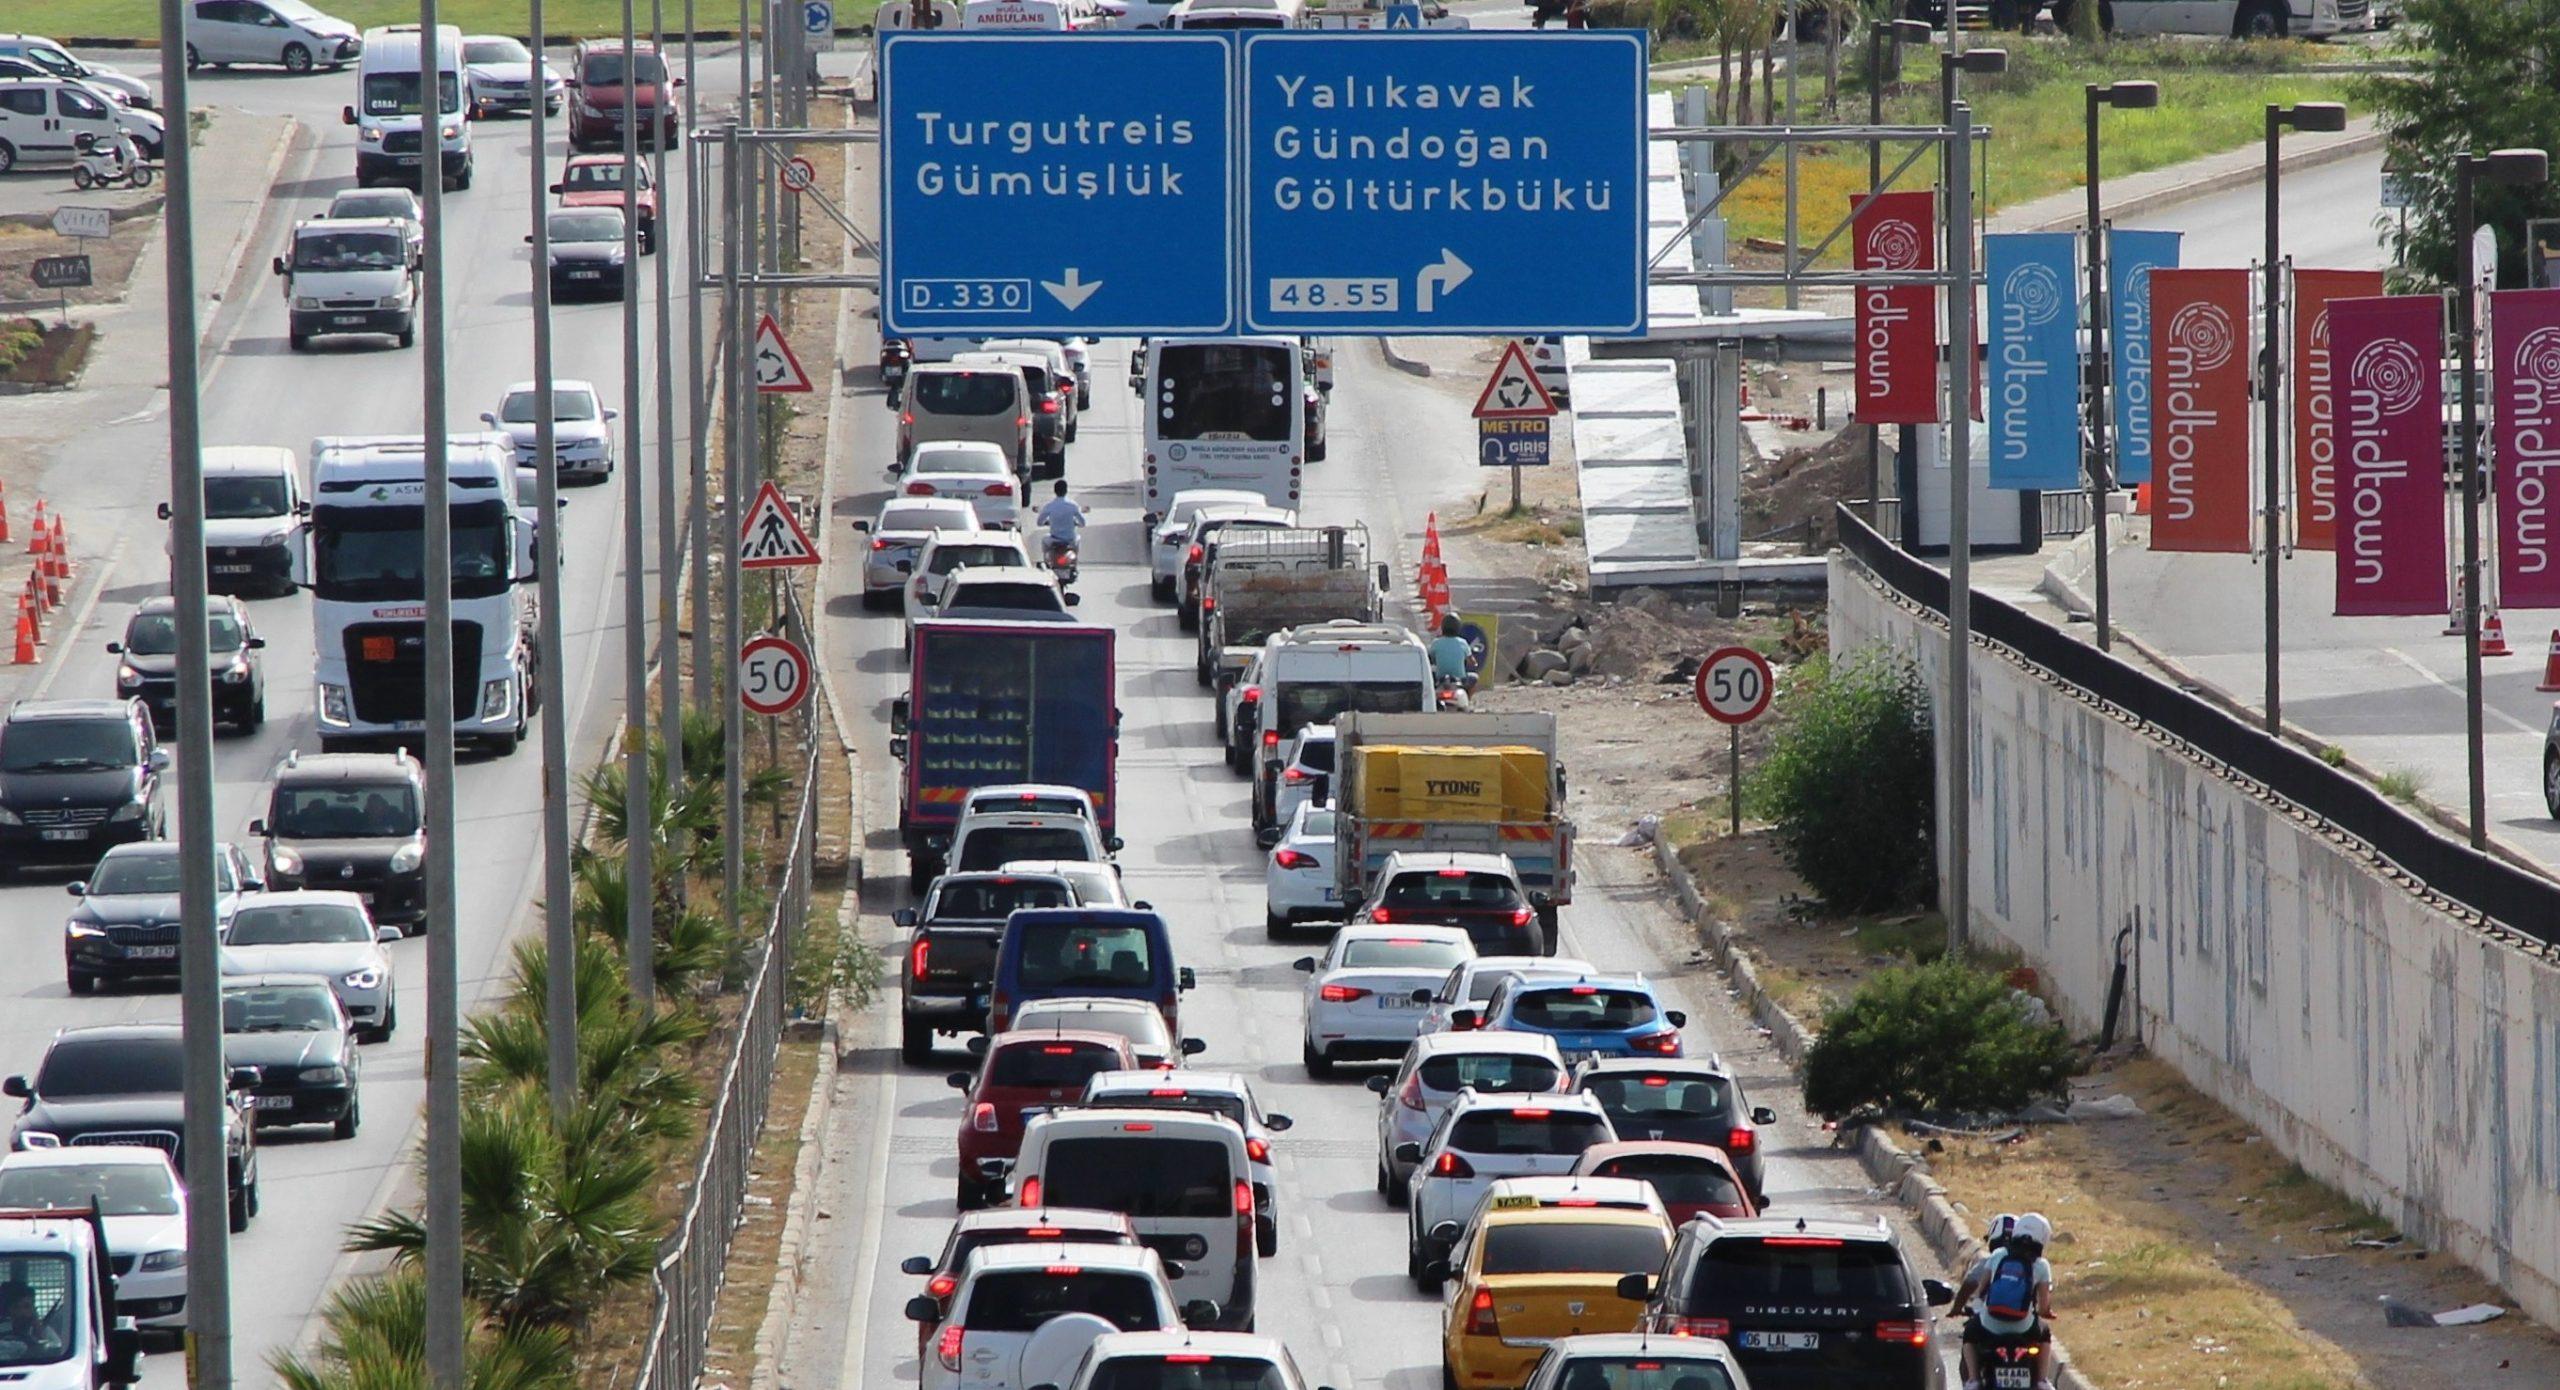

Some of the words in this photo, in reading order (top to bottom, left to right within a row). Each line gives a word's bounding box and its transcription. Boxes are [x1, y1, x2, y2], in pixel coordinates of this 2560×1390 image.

[977, 14, 1045, 24] AMBULANS
[1274, 75, 1536, 109] Yalıkavak
[916, 112, 1194, 154] Turgutreis
[1274, 125, 1549, 168] Gündoğan
[916, 162, 1184, 201] Gümüşlük
[1274, 177, 1612, 212] Göltürkbükü
[39, 259, 89, 278] VitrA
[912, 284, 1021, 308] D.330
[1279, 284, 1390, 308] 48.55
[2003, 303, 2048, 461] midtown
[1482, 420, 1547, 433] METRO
[2167, 346, 2218, 520] midtown
[1508, 440, 1547, 454] GİRİŞ
[2350, 389, 2408, 584] midtown
[2513, 378, 2560, 574] midtown
[748, 659, 795, 694] 50
[1712, 667, 1759, 702] 50
[1426, 780, 1481, 797] YTONG
[1745, 1306, 1860, 1316] DISCOVERY
[1746, 1333, 1761, 1347] 06
[1768, 1334, 1788, 1348] LAL
[1803, 1335, 1818, 1348] 37
